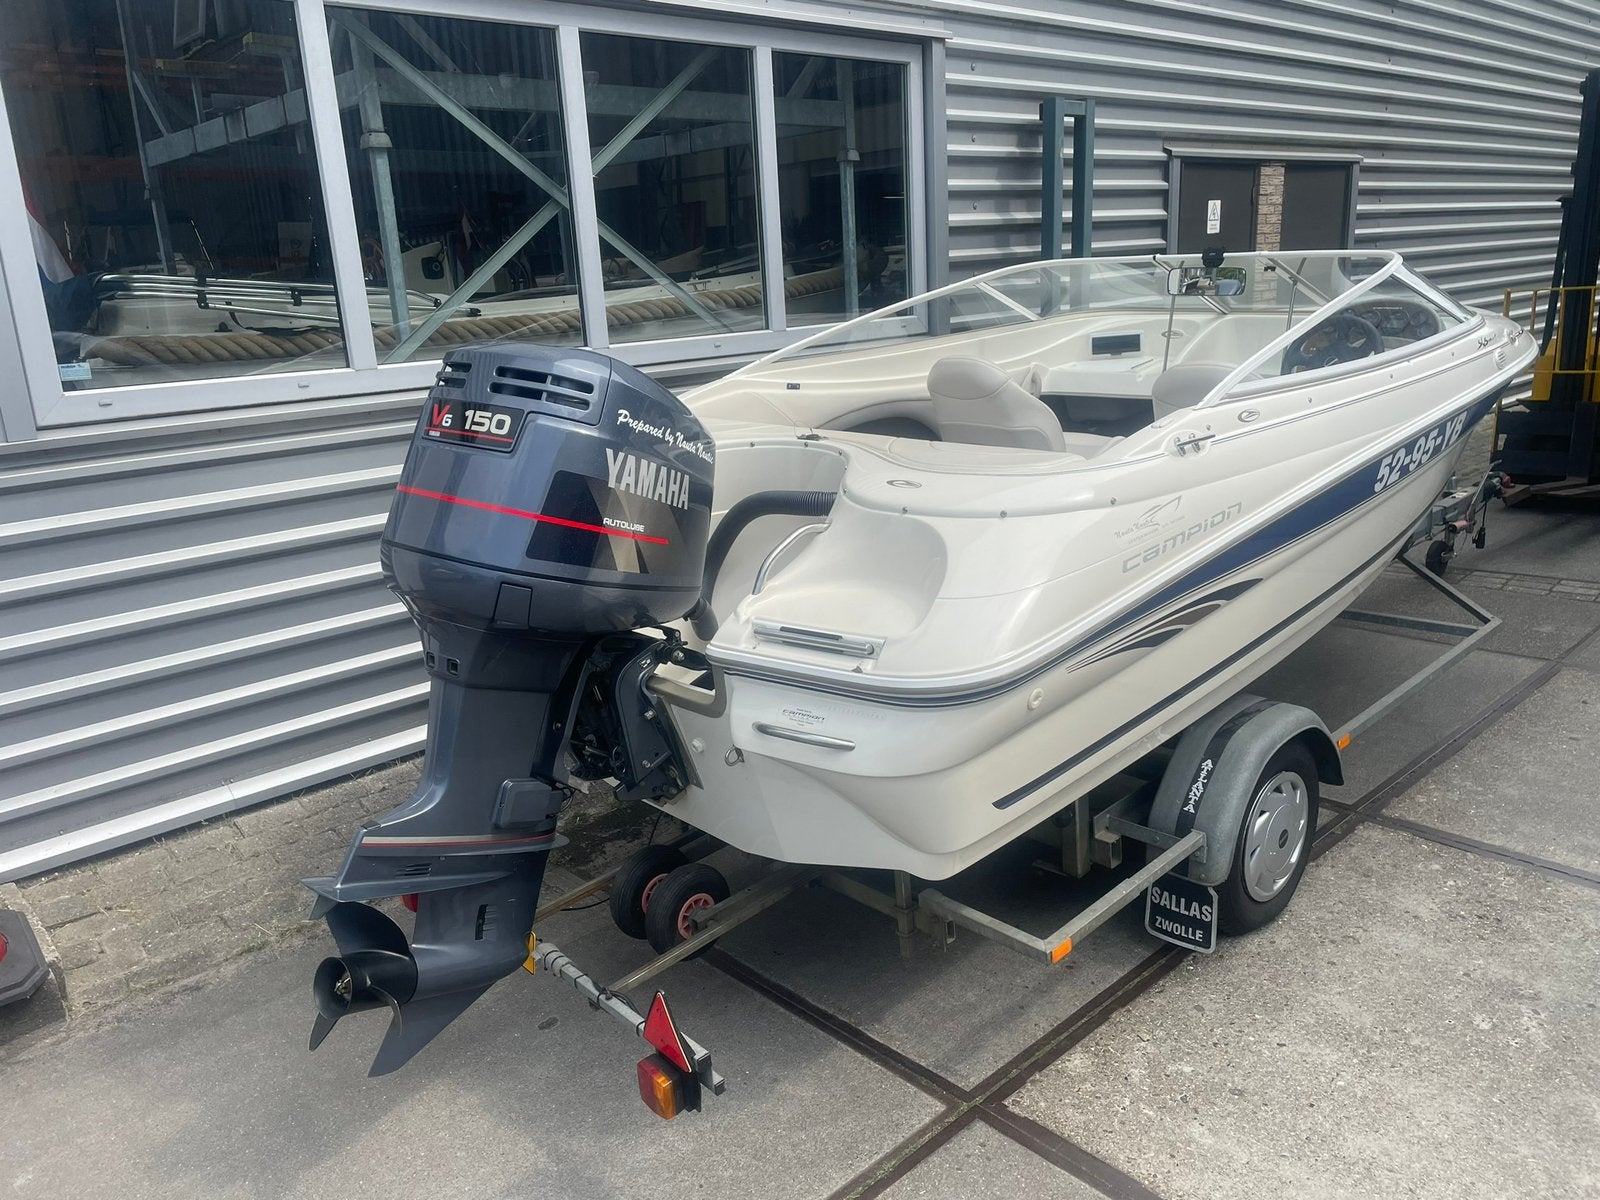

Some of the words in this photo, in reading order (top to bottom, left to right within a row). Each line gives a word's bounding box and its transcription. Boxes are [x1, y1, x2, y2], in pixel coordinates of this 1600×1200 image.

[432, 402, 453, 428] V6
[464, 409, 512, 435] 150
[616, 409, 664, 439] Prepared
[664, 428, 675, 447] by
[675, 431, 696, 455] Nauta
[1374, 410, 1468, 493] 52-95-YB
[605, 447, 690, 511] YAMAHA
[602, 517, 645, 533] AUTOLUBE
[1183, 758, 1214, 814] ATLANTA
[1151, 886, 1213, 923] SALLAS
[1155, 914, 1204, 943] ZWOLLE
